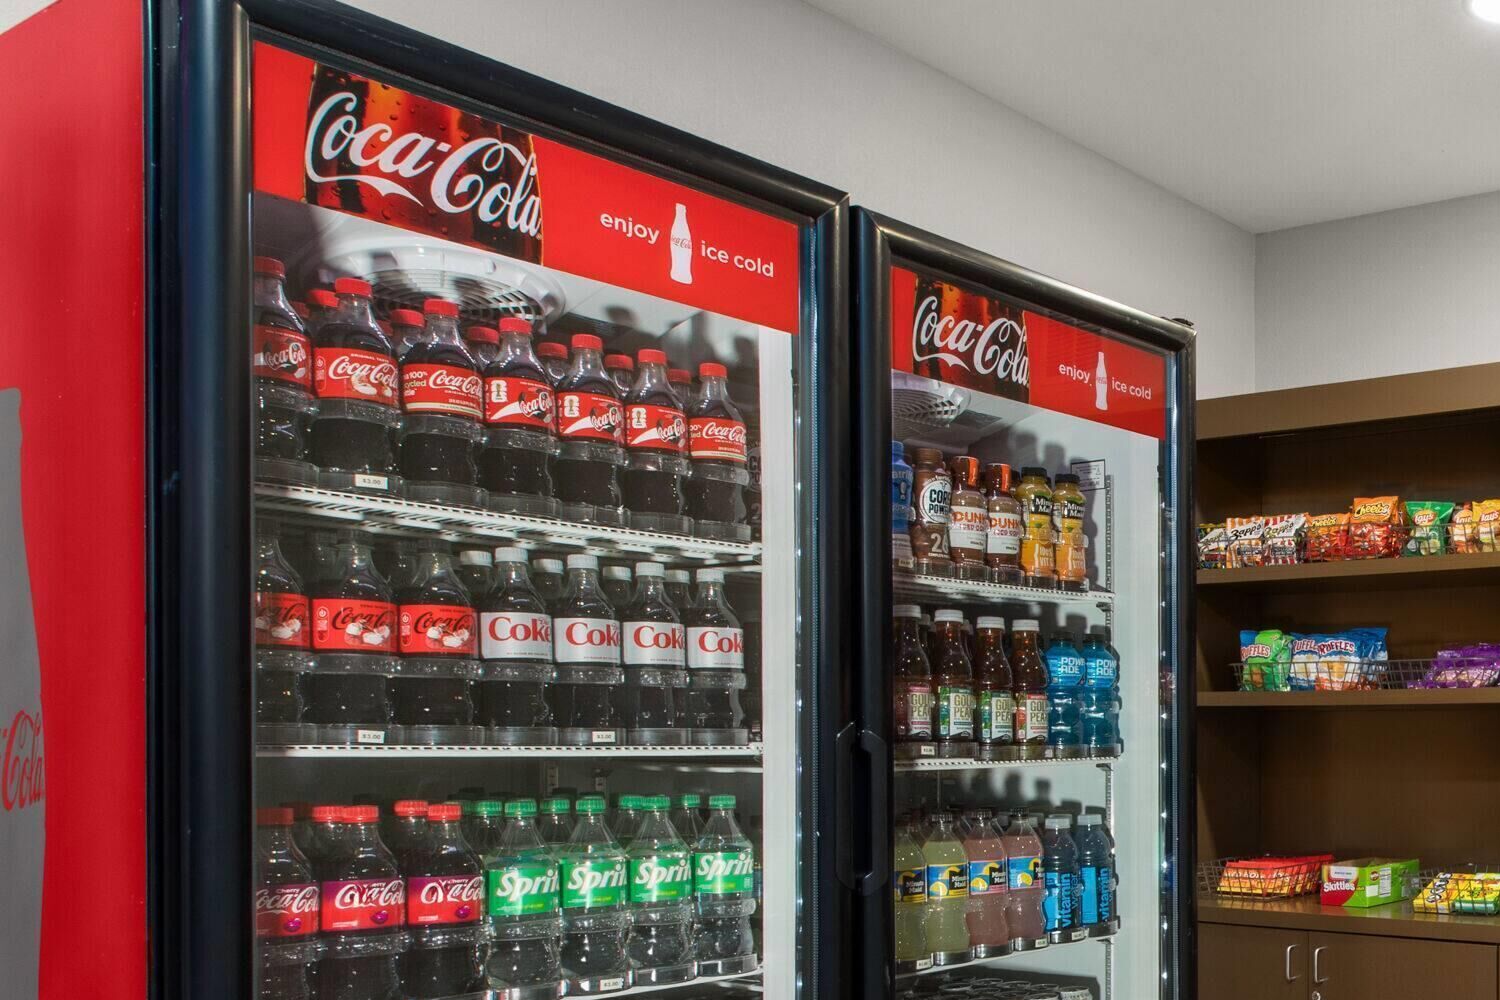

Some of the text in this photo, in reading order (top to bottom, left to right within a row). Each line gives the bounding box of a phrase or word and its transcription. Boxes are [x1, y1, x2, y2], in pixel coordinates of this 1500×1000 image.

[304, 91, 542, 237] Coca-Cola
[600, 212, 775, 279] enjoy ice cold
[912, 295, 1030, 388] Coca-Cola
[1058, 363, 1152, 400] enjoy ice cold
[952, 511, 987, 524] DUNK
[988, 517, 1021, 529] DUNK
[1354, 501, 1390, 518] Cheetos
[1227, 517, 1262, 541] Zapp's
[698, 630, 744, 653] Cok
[1292, 639, 1318, 652] RUFFL
[1317, 640, 1356, 654] RUFFLES
[567, 864, 627, 895] Sprit
[635, 859, 692, 889] Sprit
[697, 853, 754, 881] Sprit
[496, 868, 560, 902] Sprit
[1099, 867, 1110, 923] vitamin
[1323, 881, 1356, 893] Skittles
[1059, 872, 1071, 928] vitamin
